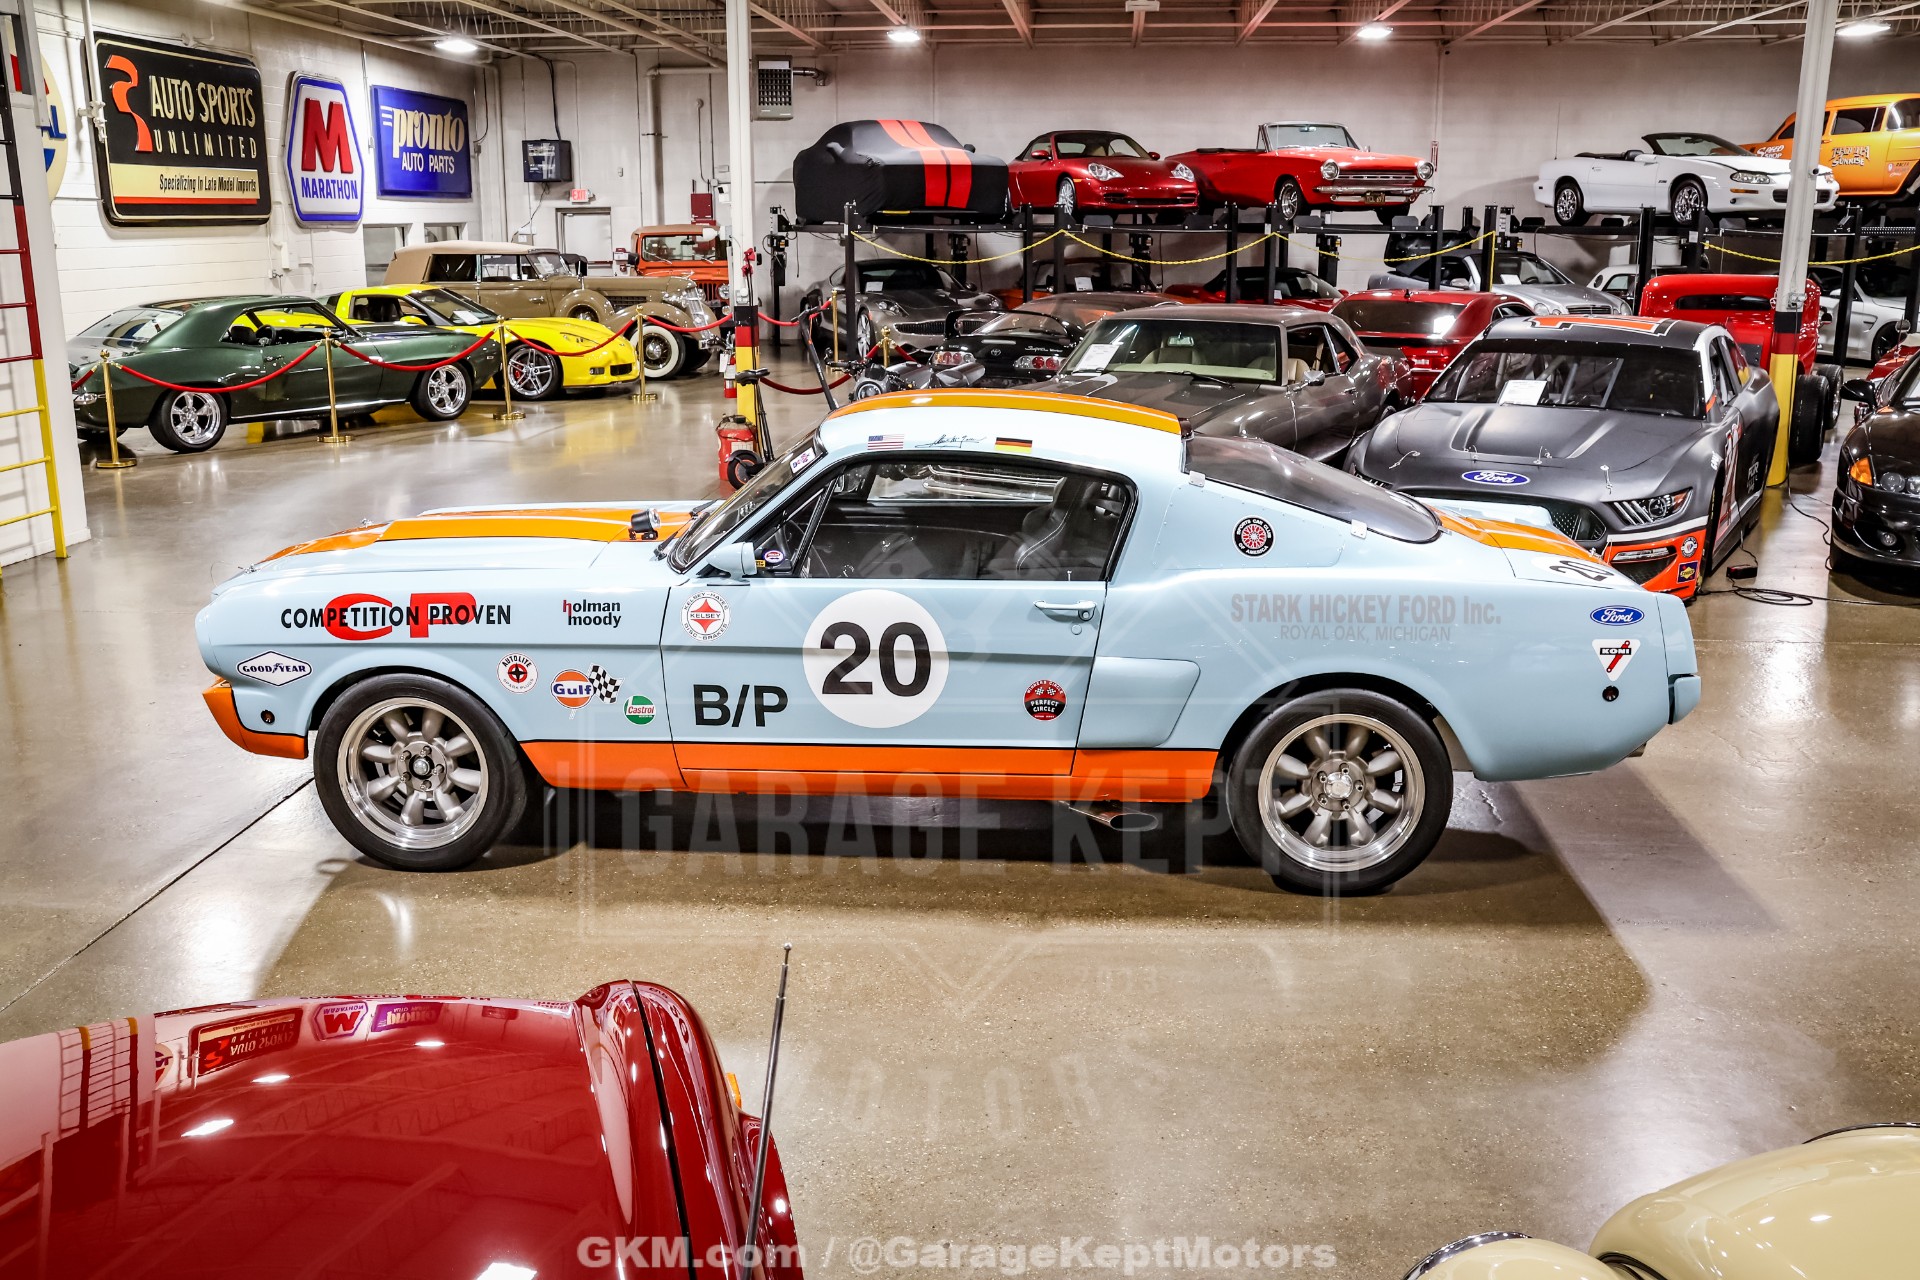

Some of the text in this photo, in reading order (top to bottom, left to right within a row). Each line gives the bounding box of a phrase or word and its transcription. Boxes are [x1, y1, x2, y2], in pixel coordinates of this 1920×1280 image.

[149, 75, 256, 128] AUTO SPORTS
[301, 98, 354, 174] M
[392, 107, 465, 159] pronto
[153, 129, 257, 159] UNLIMITED
[401, 151, 455, 174] AUTO PARTS
[1831, 157, 1866, 167] SUNRISE
[160, 174, 197, 193] Specializing
[205, 174, 217, 191] Late
[218, 175, 235, 191] Model
[236, 177, 257, 194] Imports
[301, 176, 358, 199] MARATHON
[572, 189, 587, 201] EXIT
[1473, 471, 1517, 484] Ford
[1549, 560, 1615, 582] 20
[563, 599, 621, 613] holman
[1230, 593, 1502, 625] STARK HICKEY FORD Inc.
[1600, 608, 1634, 623] Ford
[281, 605, 511, 629] COMPETITION PROVEN
[568, 612, 622, 628] moody
[1280, 625, 1451, 643] ROYAL OAK, MICHIGAN
[501, 655, 532, 668] AUTOLITE
[819, 621, 932, 698] 20
[552, 683, 592, 696] Gulf
[627, 705, 655, 715] Castrol
[693, 684, 789, 728] B/P
[1030, 699, 1059, 707] PERFECT
